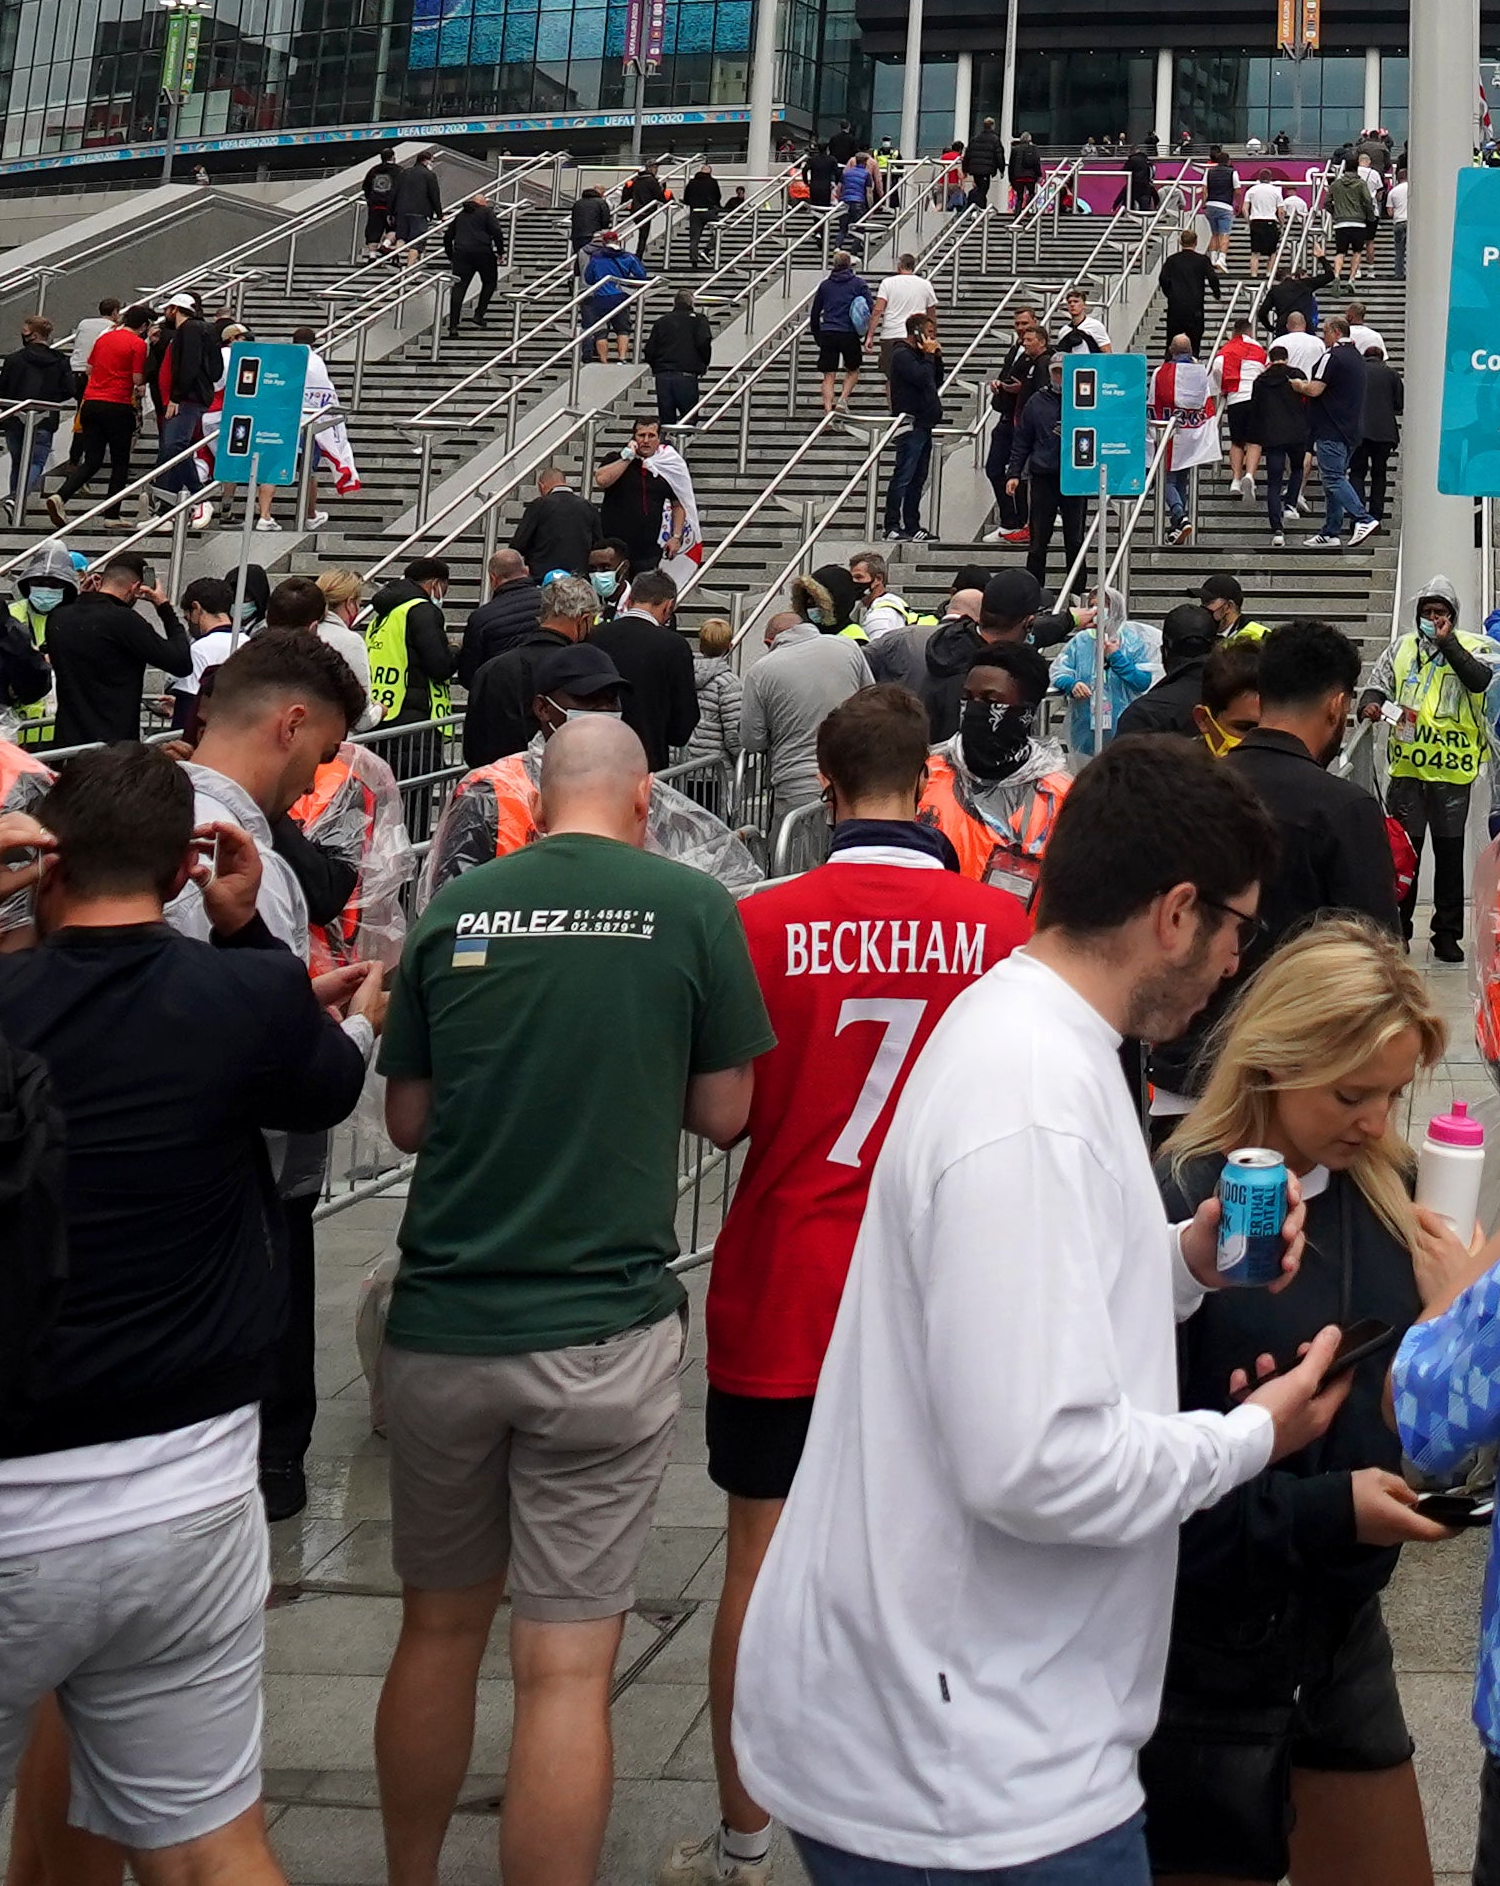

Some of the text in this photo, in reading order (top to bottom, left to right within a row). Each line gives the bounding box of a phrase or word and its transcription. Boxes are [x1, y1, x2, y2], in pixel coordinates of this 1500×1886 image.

[604, 112, 685, 126] UEFA ERO 2020
[397, 123, 468, 137] UEFA EURO 2020
[456, 909, 569, 935] PARLEZ
[644, 911, 655, 922] N
[642, 924, 655, 935] W
[784, 920, 987, 977] BECKHAM
[826, 997, 929, 1168] 7
